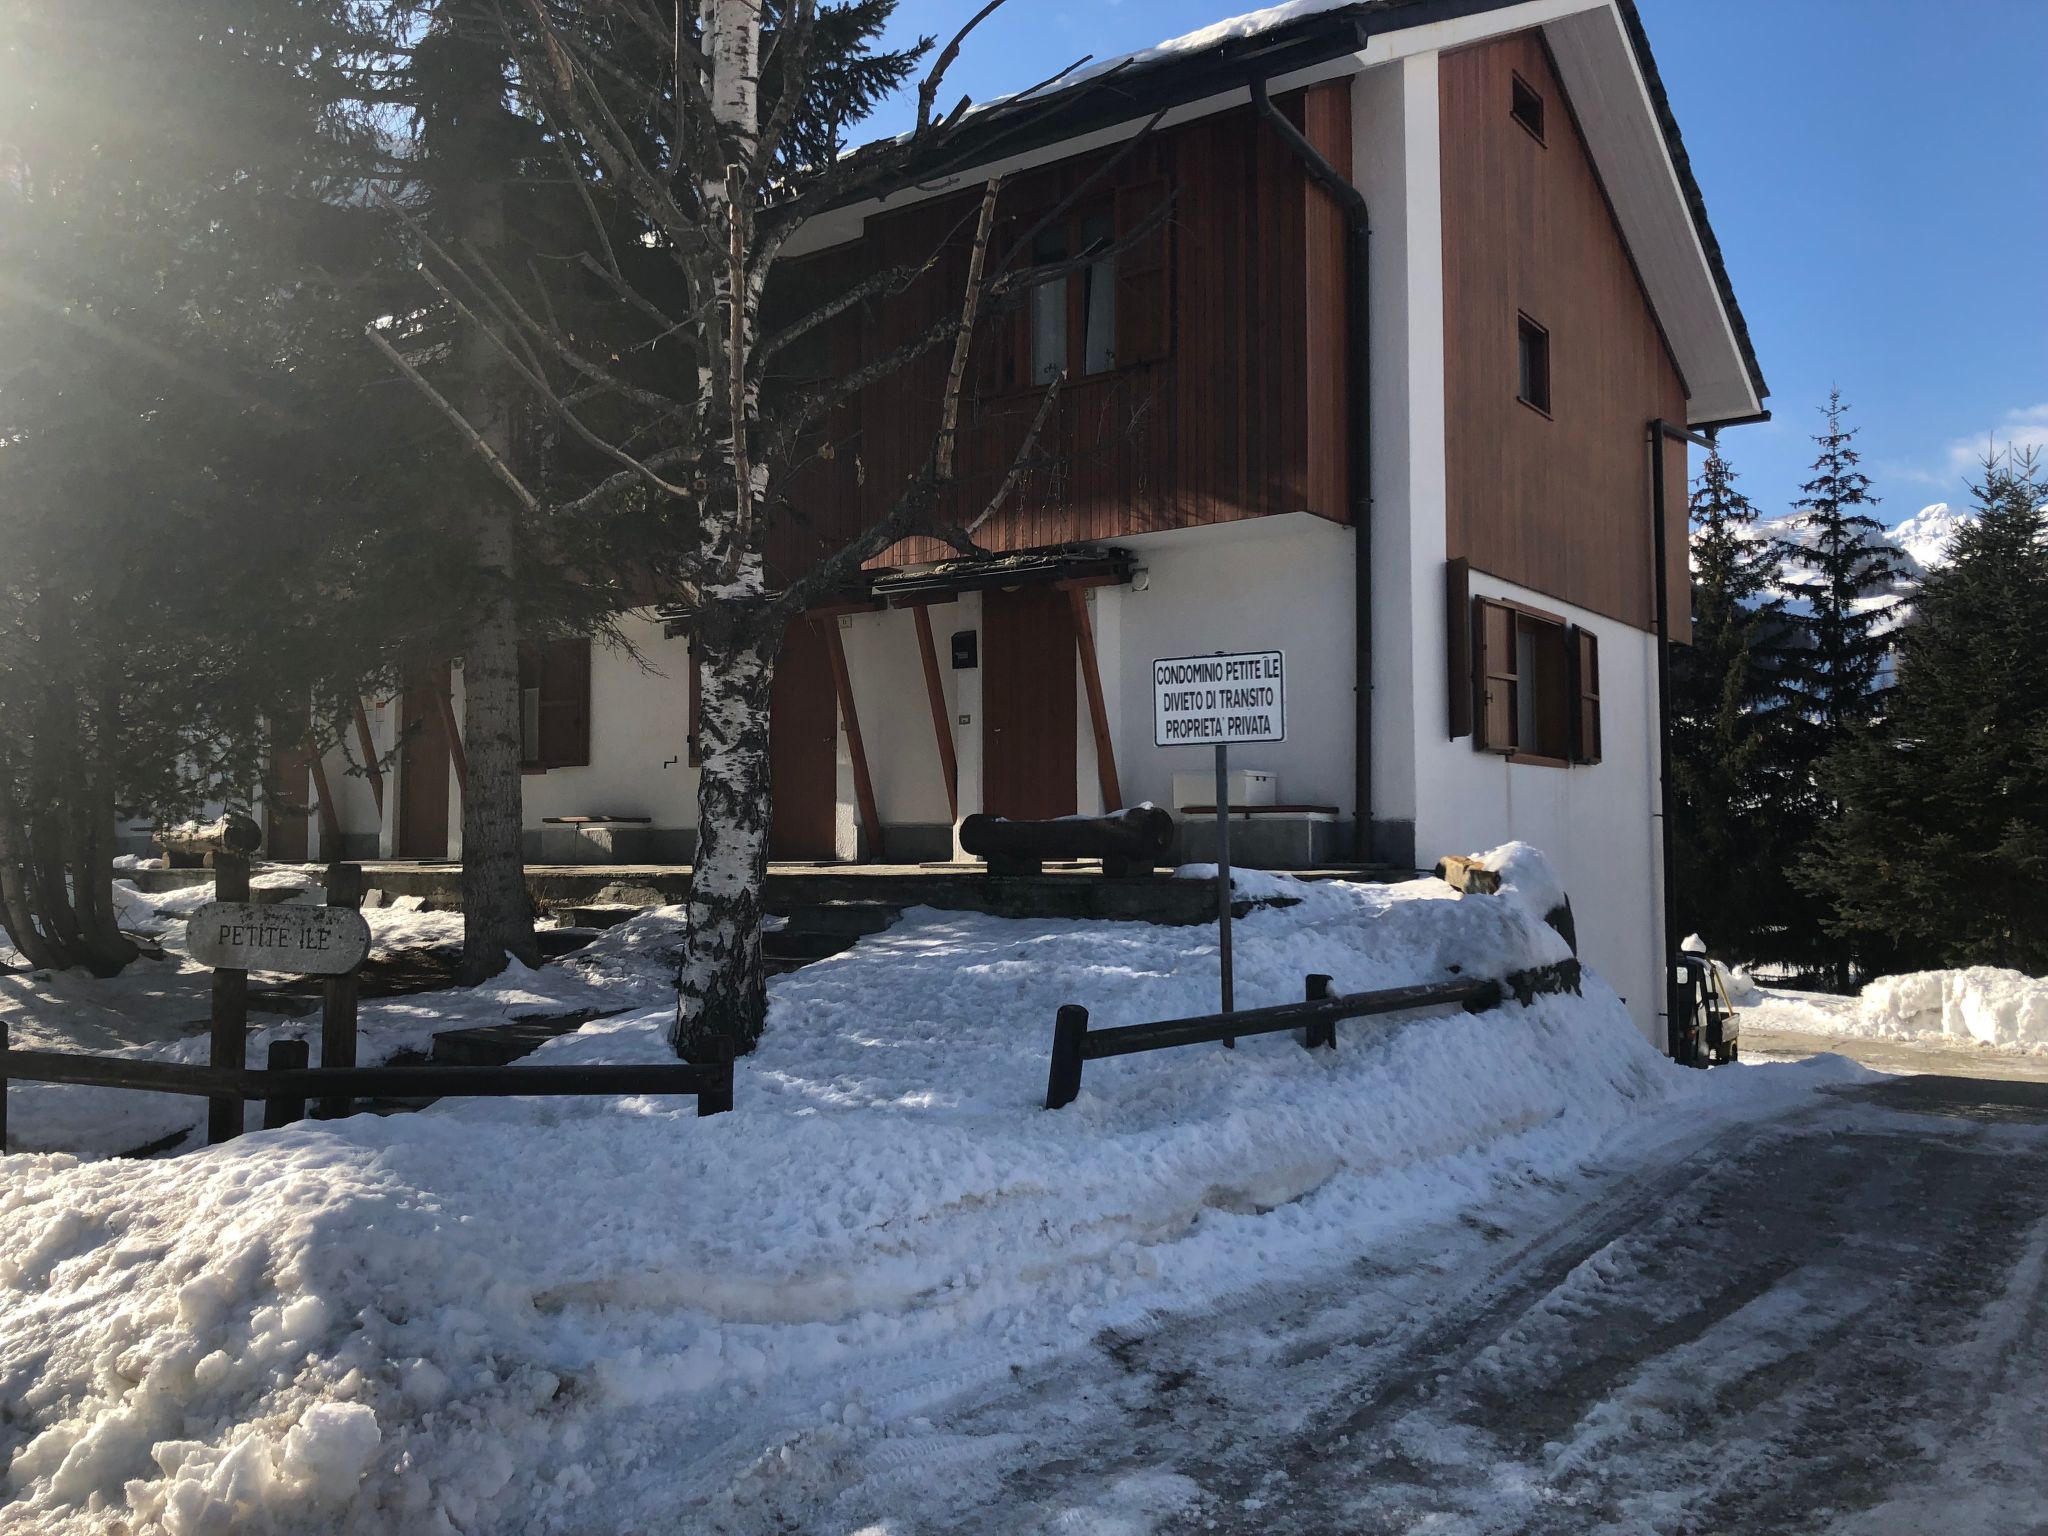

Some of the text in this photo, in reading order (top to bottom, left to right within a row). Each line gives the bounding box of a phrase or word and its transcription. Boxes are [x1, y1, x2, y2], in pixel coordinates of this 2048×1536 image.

[1157, 663, 1223, 685] CONDOMINIO
[1226, 660, 1261, 681] PETITE
[1164, 687, 1273, 712] DIVIETO DI TRANSITO
[1228, 715, 1271, 736] PRIVATA
[218, 924, 290, 948] PETITE
